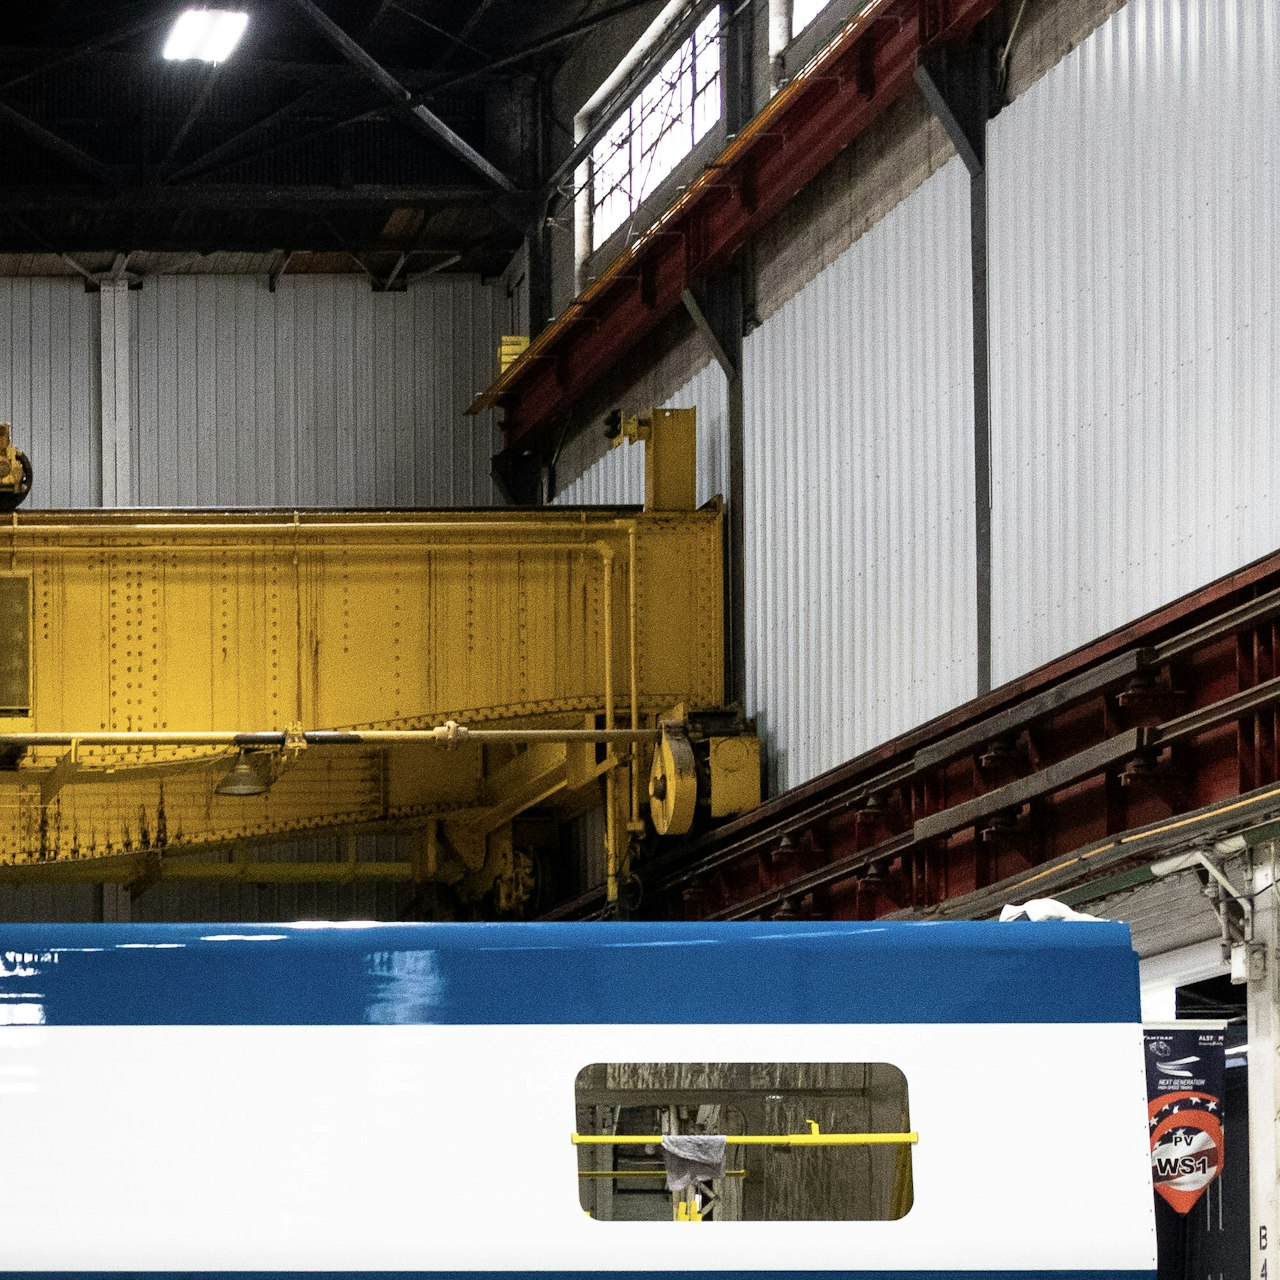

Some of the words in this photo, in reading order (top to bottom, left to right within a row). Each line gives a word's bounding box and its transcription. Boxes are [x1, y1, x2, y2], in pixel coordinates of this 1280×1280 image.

[1173, 1135, 1195, 1147] PV
[1156, 1157, 1208, 1176] WS1
[1259, 1226, 1268, 1250] B
